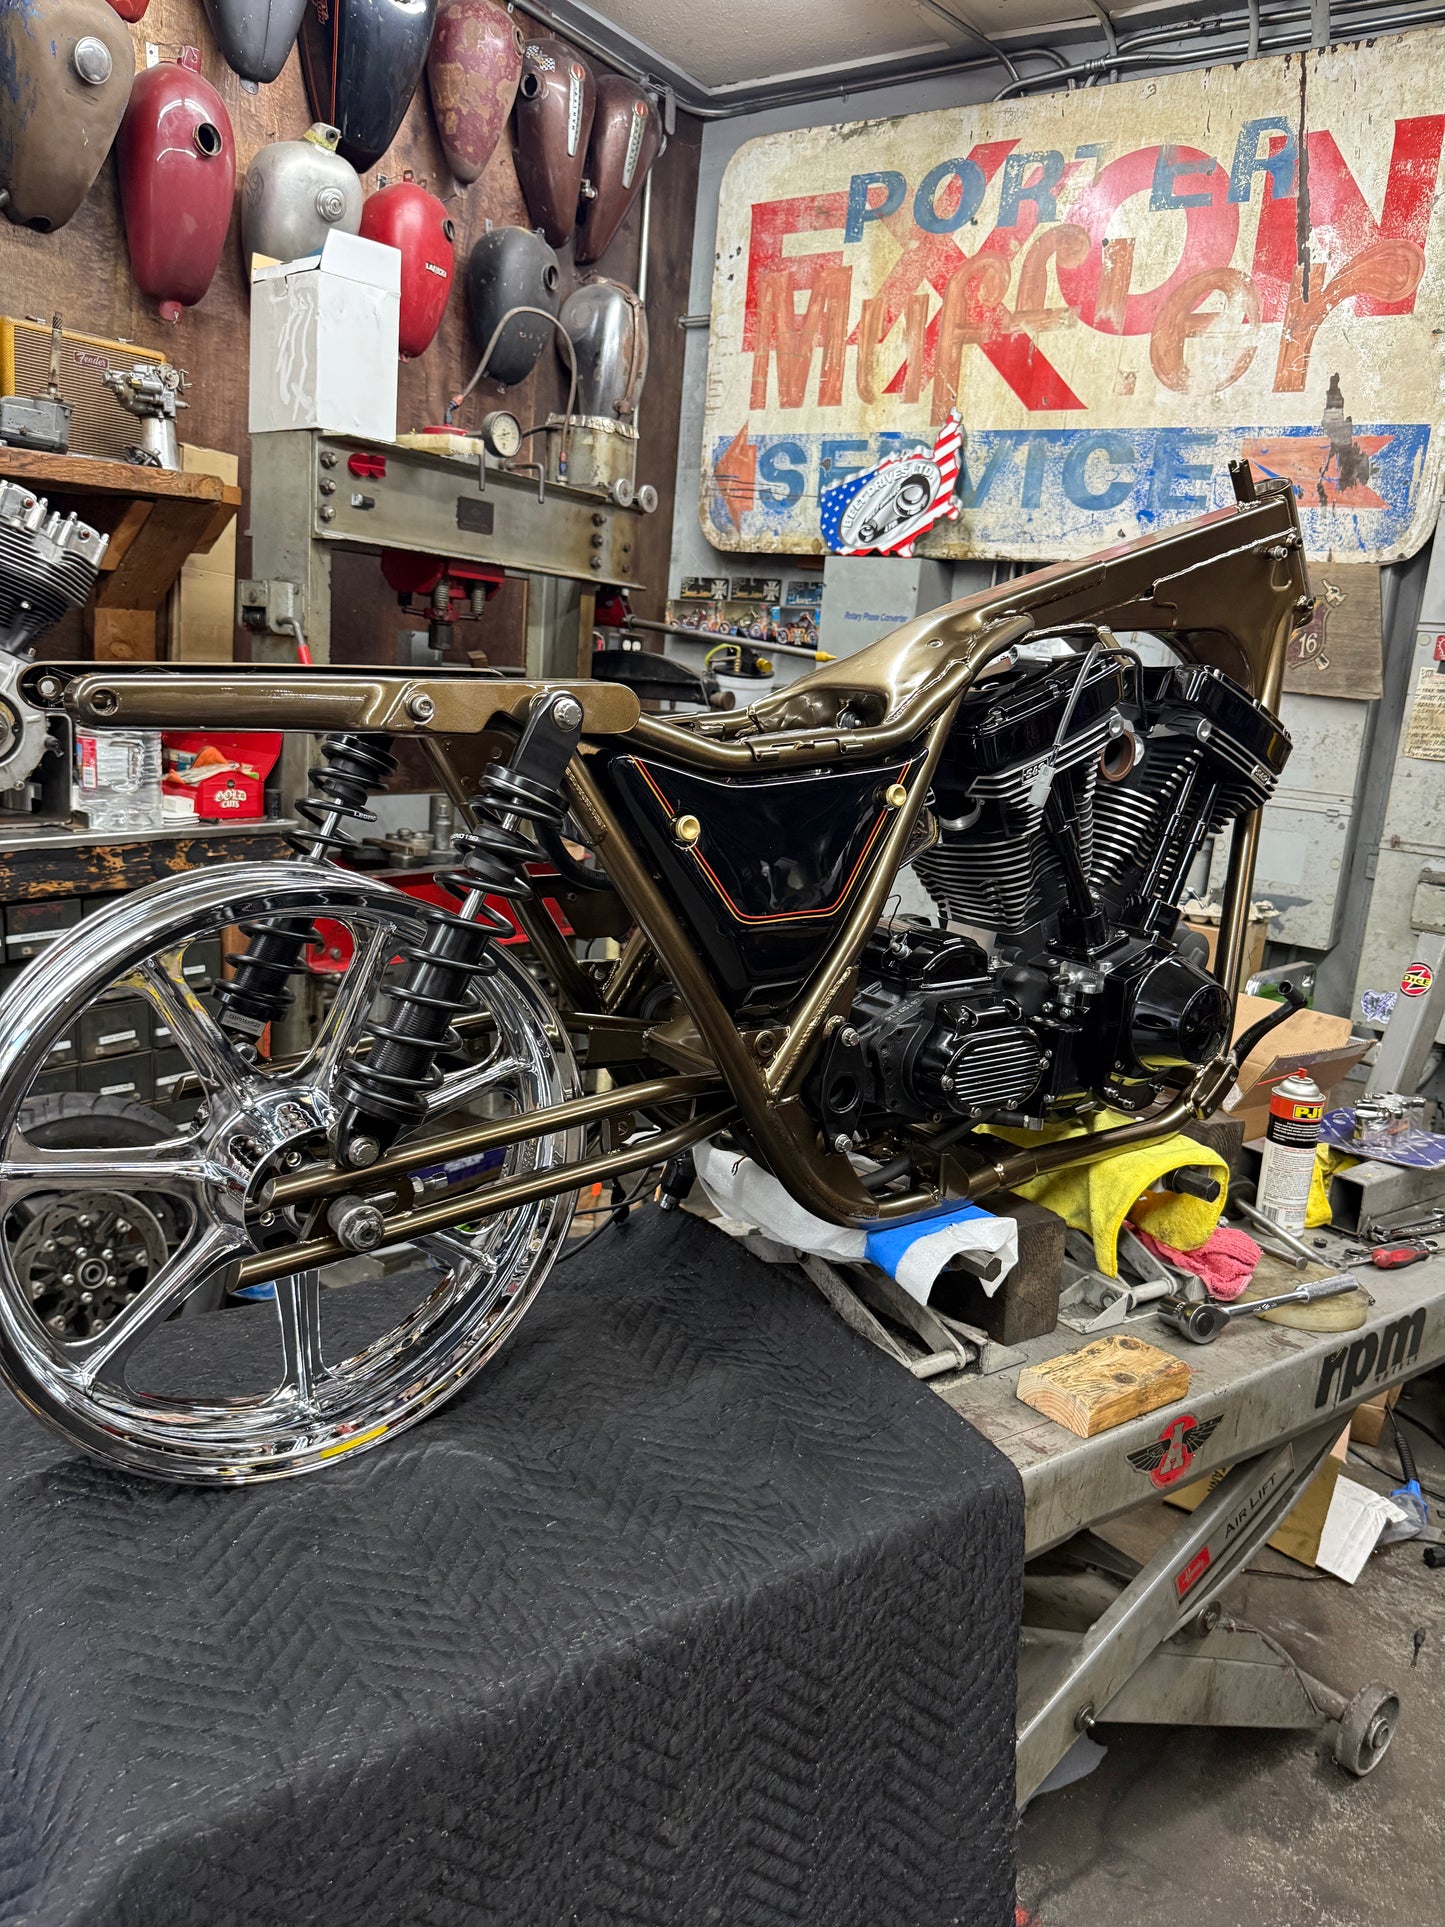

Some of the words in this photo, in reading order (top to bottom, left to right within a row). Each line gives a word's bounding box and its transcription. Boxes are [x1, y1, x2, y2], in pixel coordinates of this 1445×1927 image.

[844, 116, 1300, 244] PORTER
[77, 352, 107, 367] Fender
[843, 496, 867, 529] BELT
[867, 467, 911, 498] DRIVES
[845, 611, 861, 621] Rotary
[863, 612, 880, 621] Phase
[881, 613, 908, 622] Converter
[1298, 633, 1318, 658] 16
[214, 788, 247, 802] GOLD
[221, 800, 240, 808] CUTS
[1294, 1106, 1322, 1119] PJ1
[1315, 1307, 1426, 1409] rpm
[1225, 1507, 1248, 1539] AIR
[1250, 1472, 1277, 1510] LIFT
